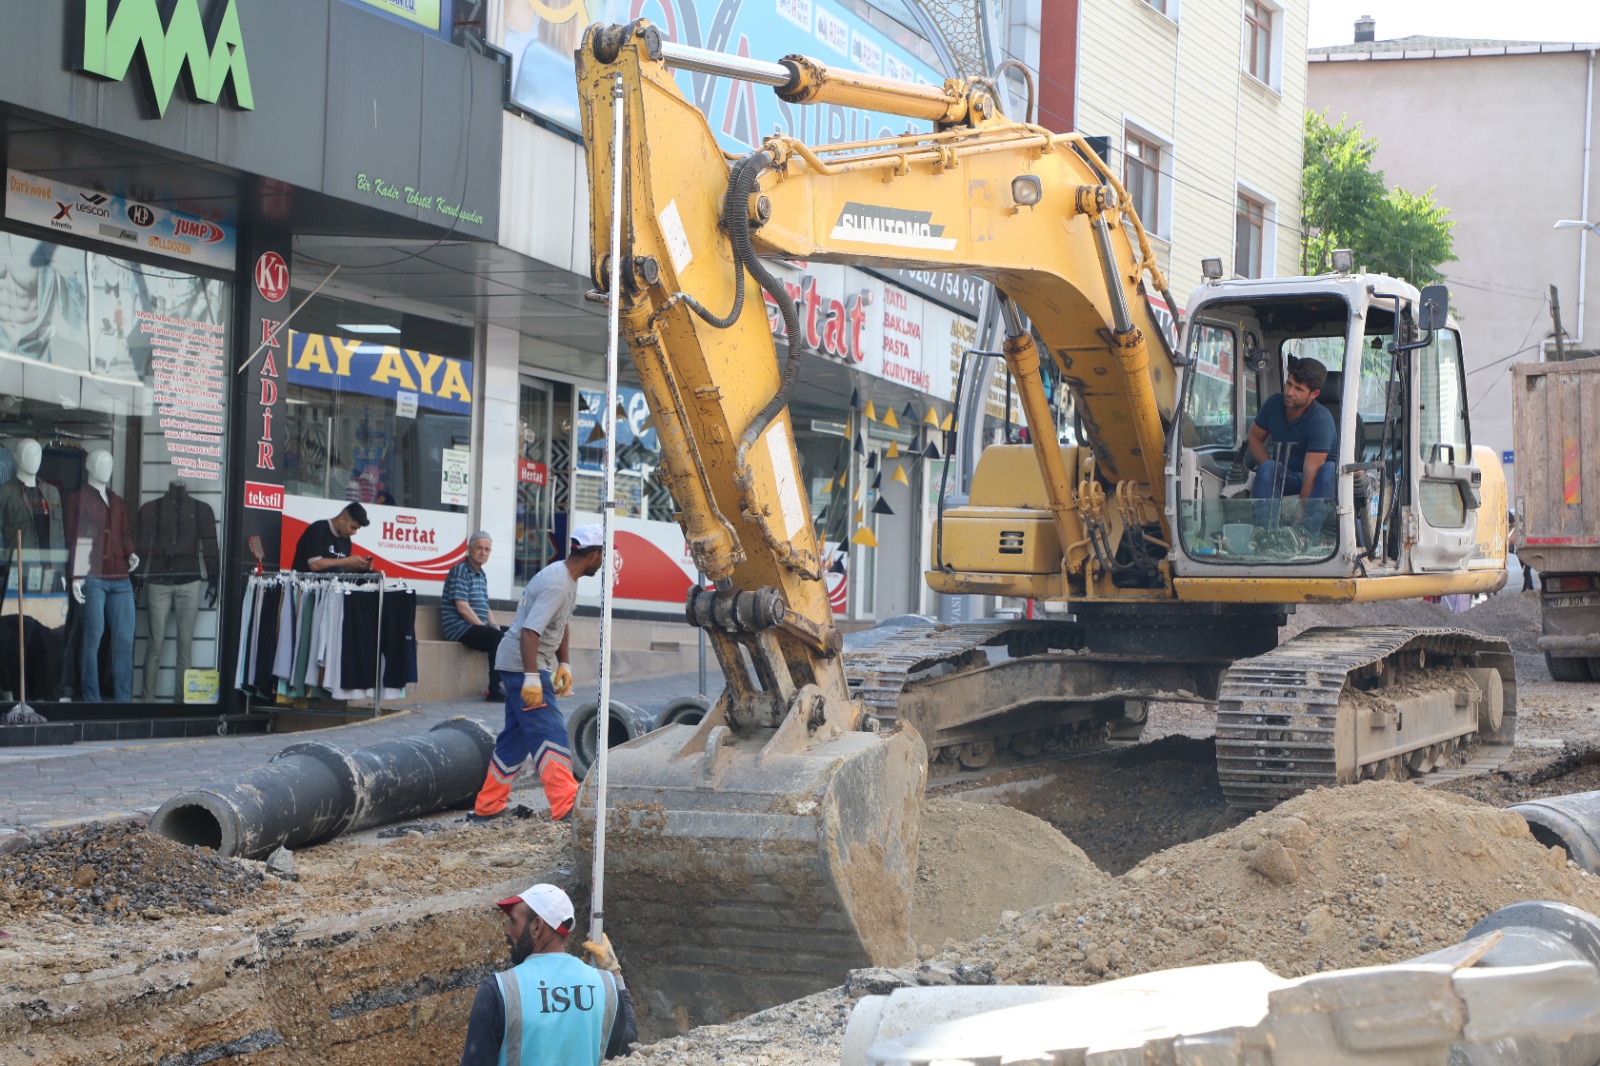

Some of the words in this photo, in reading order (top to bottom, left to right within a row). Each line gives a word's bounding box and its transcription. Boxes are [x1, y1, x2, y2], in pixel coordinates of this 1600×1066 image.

[10, 175, 52, 200] Darkwood
[357, 173, 370, 192] Bir
[374, 178, 399, 200] Kadir
[404, 186, 432, 209] Tekstil
[173, 218, 208, 239] JUMP
[841, 212, 932, 240] SUMITOMO
[148, 235, 192, 256] BULLDOZER
[259, 253, 288, 292] KT
[885, 287, 907, 311] TATLI
[962, 278, 975, 306] 94
[883, 311, 921, 341] BAKLAVA
[882, 335, 909, 359] PASTA
[882, 360, 930, 394] KURUYEMİŞ
[256, 317, 281, 471] KADİR
[521, 467, 543, 484] Hertat
[248, 491, 281, 508] tekstil
[382, 521, 435, 544] Hertat
